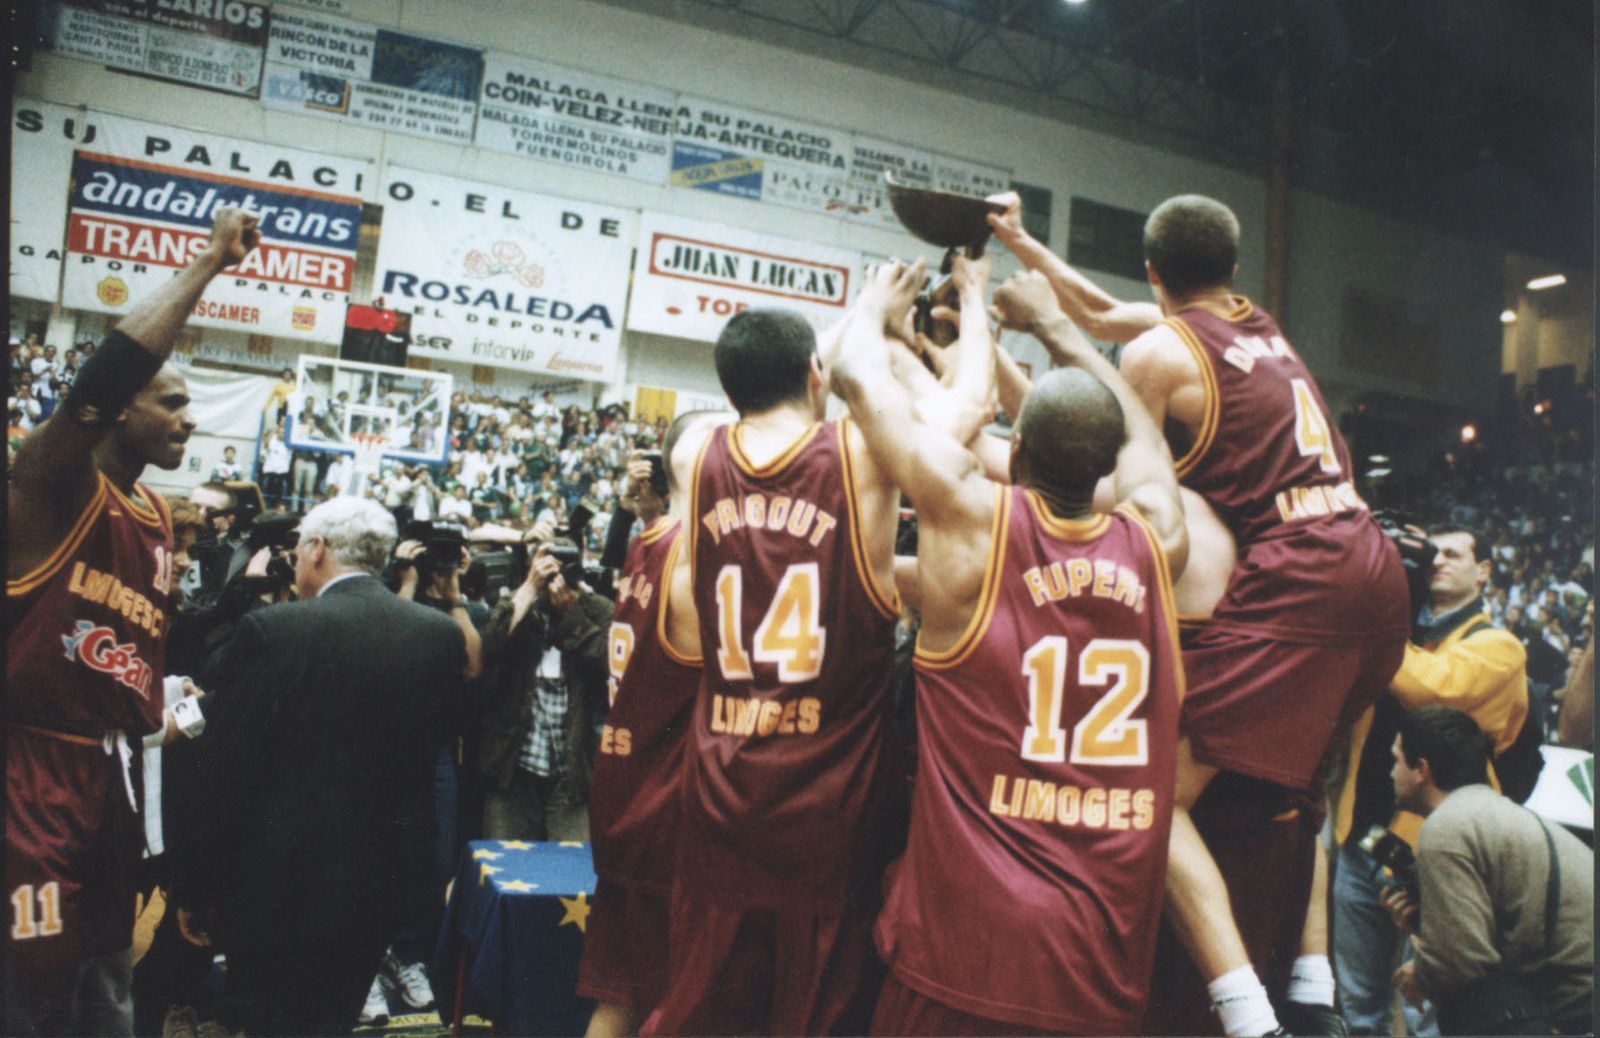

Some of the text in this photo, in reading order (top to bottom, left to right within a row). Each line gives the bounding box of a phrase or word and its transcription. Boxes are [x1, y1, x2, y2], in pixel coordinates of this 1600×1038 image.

[270, 27, 326, 48] RINCON
[329, 38, 348, 53] DE
[350, 43, 369, 57] LA
[281, 45, 356, 71] VICTORIA
[482, 108, 539, 129] MALAGA
[544, 122, 585, 141] LLENA
[590, 130, 607, 144] SU
[611, 132, 668, 157] PALACIO
[506, 72, 832, 149] MALAGA LLENA SU PALACIO
[511, 127, 637, 163] TORREMOLINOS
[516, 141, 628, 174] FUENGIROLA
[16, 109, 97, 144] SU
[464, 193, 521, 219] EL
[561, 211, 620, 238] DE
[80, 219, 346, 288] TRANSAMER
[81, 255, 148, 274] POR
[663, 245, 740, 280] JUAN
[382, 269, 615, 330] ROSALEDA
[466, 313, 600, 343] DEPORTE
[1290, 378, 1342, 474] 4
[716, 561, 827, 684] 14
[1021, 635, 1151, 766] 12
[989, 774, 1155, 830] LIMOGES
[10, 881, 63, 940] 11
